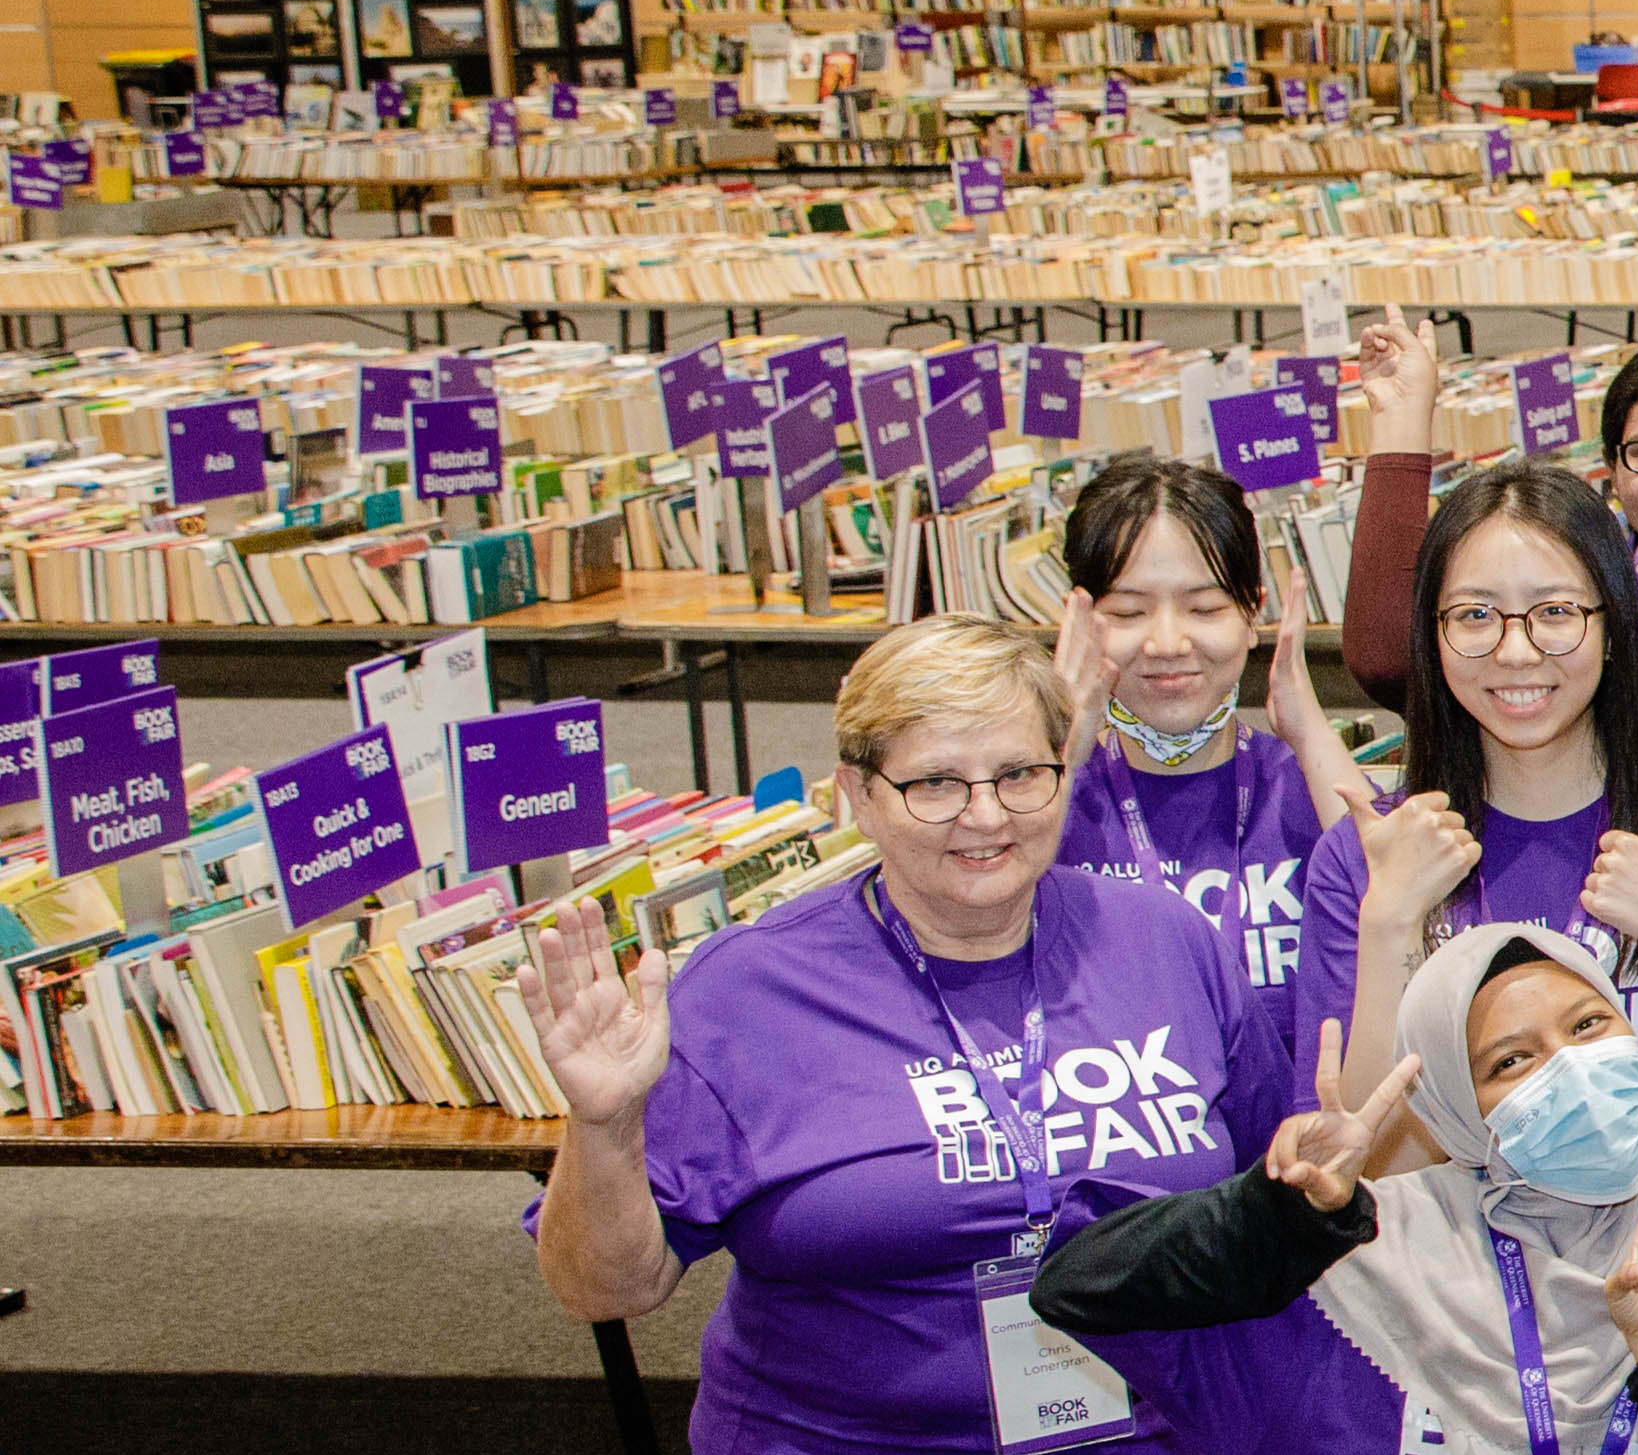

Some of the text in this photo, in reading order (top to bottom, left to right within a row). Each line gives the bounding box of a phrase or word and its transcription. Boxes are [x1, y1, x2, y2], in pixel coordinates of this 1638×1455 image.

[121, 654, 156, 674] BOOK
[133, 705, 174, 731] BOOK
[555, 719, 597, 742] BOOK
[148, 724, 176, 744] FAIR
[569, 736, 601, 755] FAIR
[346, 738, 387, 767] BOOK
[361, 754, 391, 779] FAIR
[70, 772, 170, 823] Meat, Fish,
[499, 782, 578, 823] General
[312, 797, 371, 838] Quick &
[87, 813, 163, 853] Chicken
[289, 821, 405, 886] Cooking for One
[904, 1056, 944, 1077] UQ
[1043, 1091, 1219, 1177] FAIR
[1038, 1344, 1073, 1359] Chris
[1023, 1354, 1091, 1377] Lonergran
[1038, 1396, 1088, 1417] BOOK
[1055, 1409, 1090, 1426] FAIR
[1532, 1398, 1545, 1442] QUEENSLAND
[1541, 1399, 1553, 1440] UNIVERSITY
